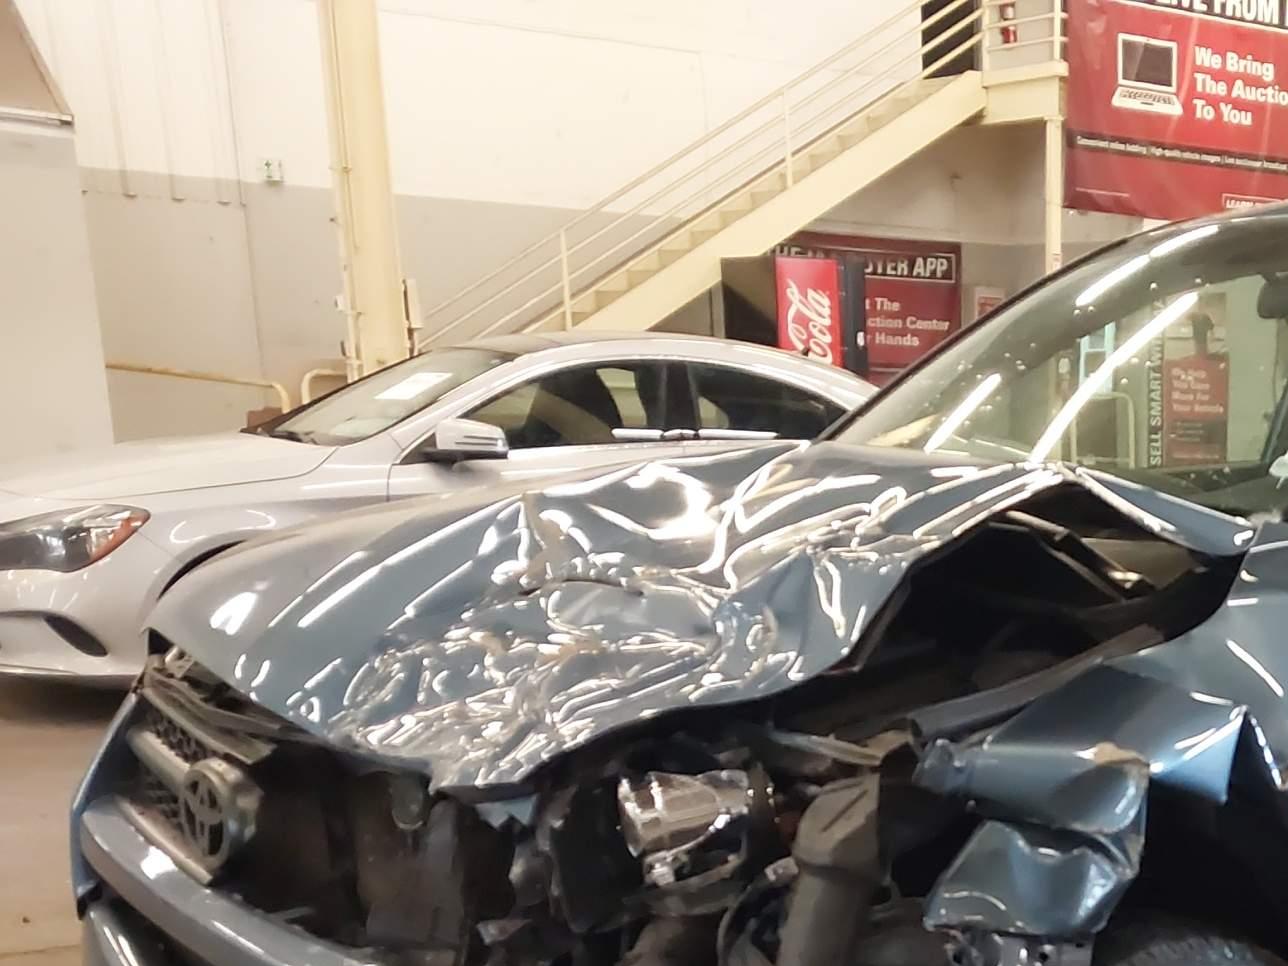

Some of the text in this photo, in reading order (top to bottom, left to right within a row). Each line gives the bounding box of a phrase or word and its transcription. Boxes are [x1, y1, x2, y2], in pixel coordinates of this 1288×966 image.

[1194, 46, 1275, 79] We Bring
[1194, 73, 1228, 97] The
[1193, 99, 1252, 126] To You
[912, 256, 948, 278] APP
[875, 297, 901, 312] The
[906, 315, 950, 331] Center
[875, 332, 920, 346] Hands
[1150, 372, 1162, 426] SMART
[1150, 431, 1162, 466] SELL
